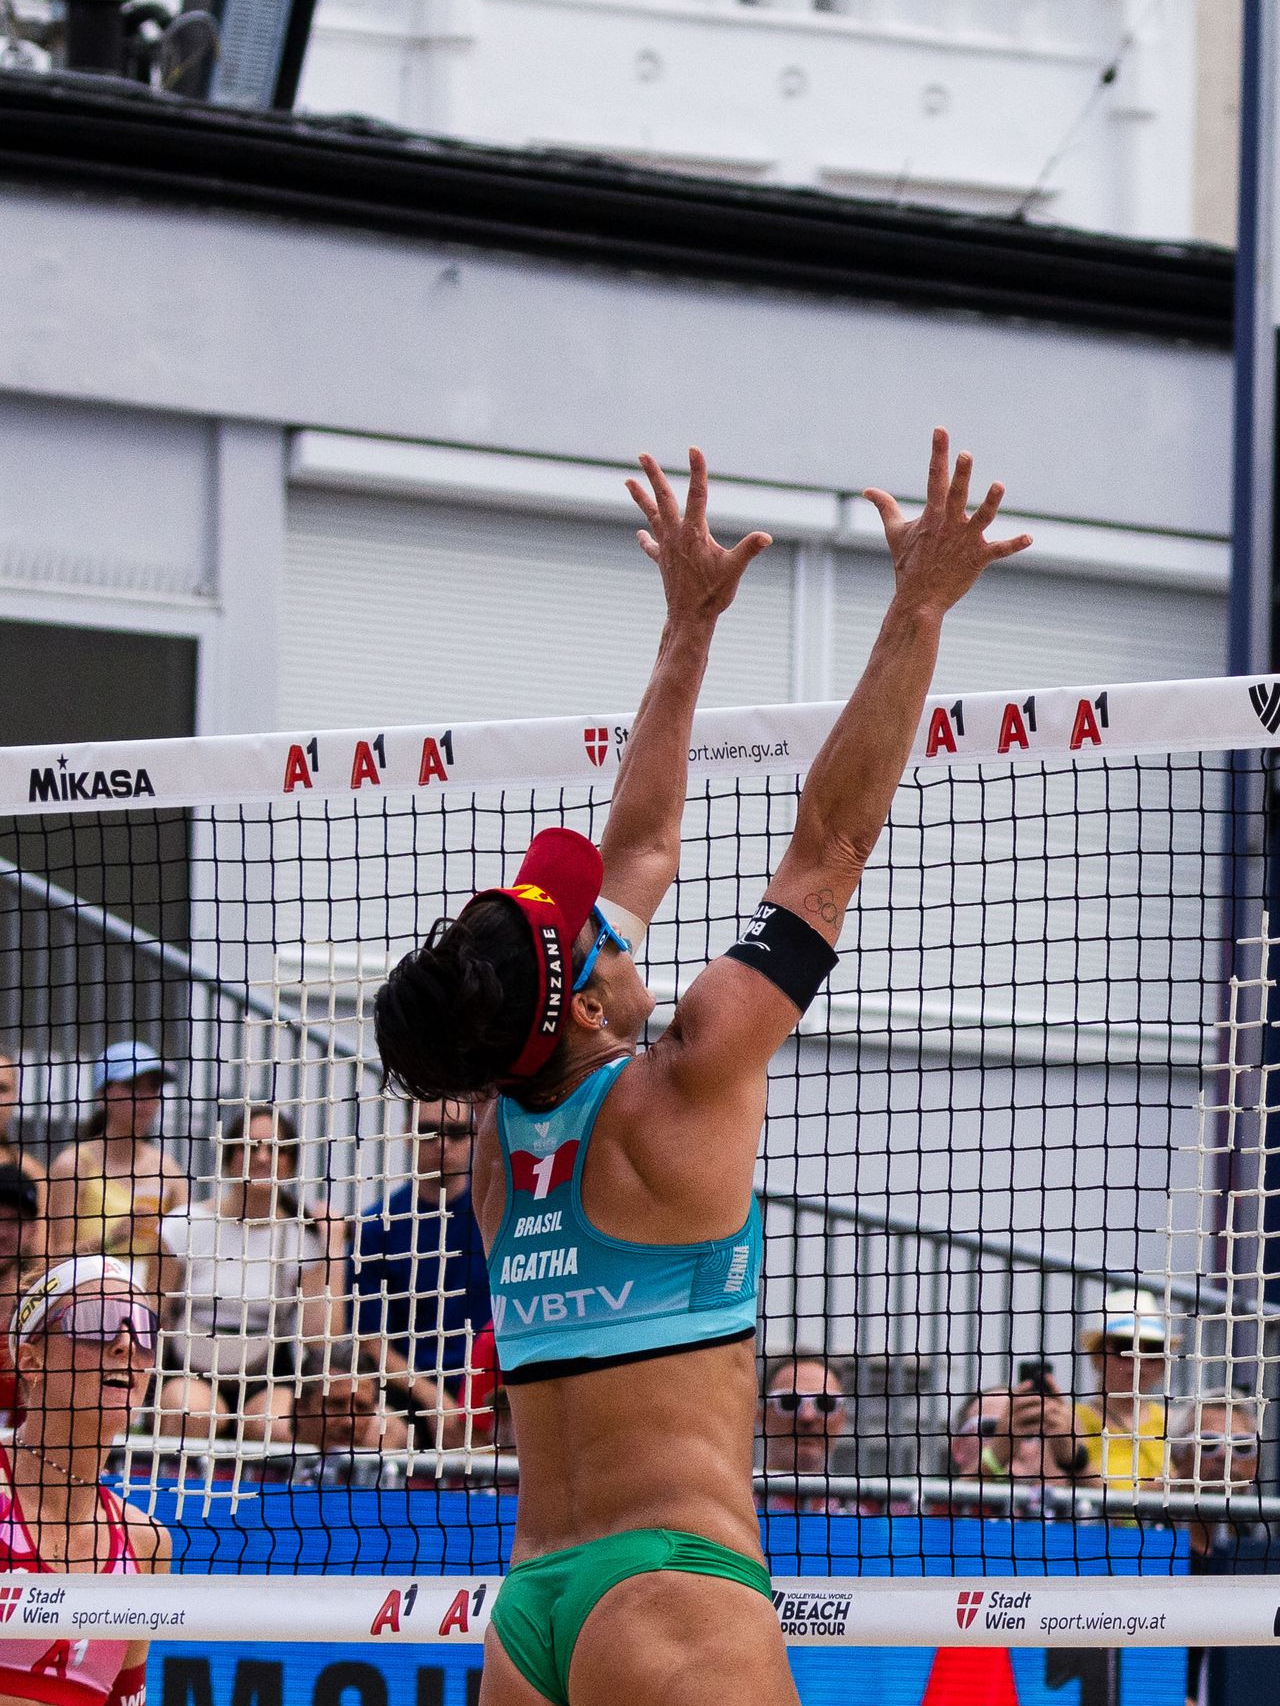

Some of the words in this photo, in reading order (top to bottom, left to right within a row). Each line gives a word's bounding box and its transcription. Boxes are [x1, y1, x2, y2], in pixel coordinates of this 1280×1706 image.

[926, 699, 965, 758] A1
[997, 695, 1037, 754] A1
[1070, 691, 1110, 751] A1
[283, 736, 319, 793] A1
[350, 733, 387, 790] A1
[418, 731, 455, 786] A1
[688, 740, 790, 763] ort.wien.gv.at
[542, 927, 562, 1033] ZINZANE
[532, 1153, 556, 1201] 1
[514, 1210, 563, 1238] BRASIL
[499, 1246, 578, 1284] AGATHA
[512, 1280, 635, 1325] VBTV
[23, 1606, 59, 1624] Wien
[26, 1587, 66, 1604] Stadt
[370, 1583, 419, 1636] A1
[438, 1584, 487, 1637] A1
[782, 1601, 852, 1621] BEACH
[989, 1591, 1032, 1609] Stadt
[71, 1608, 186, 1630] sport.wien.gv.at
[781, 1622, 808, 1636] PRO
[810, 1621, 846, 1636] TOUR
[985, 1612, 1026, 1631] Wien
[1040, 1612, 1167, 1635] sport.wien.gv.at
